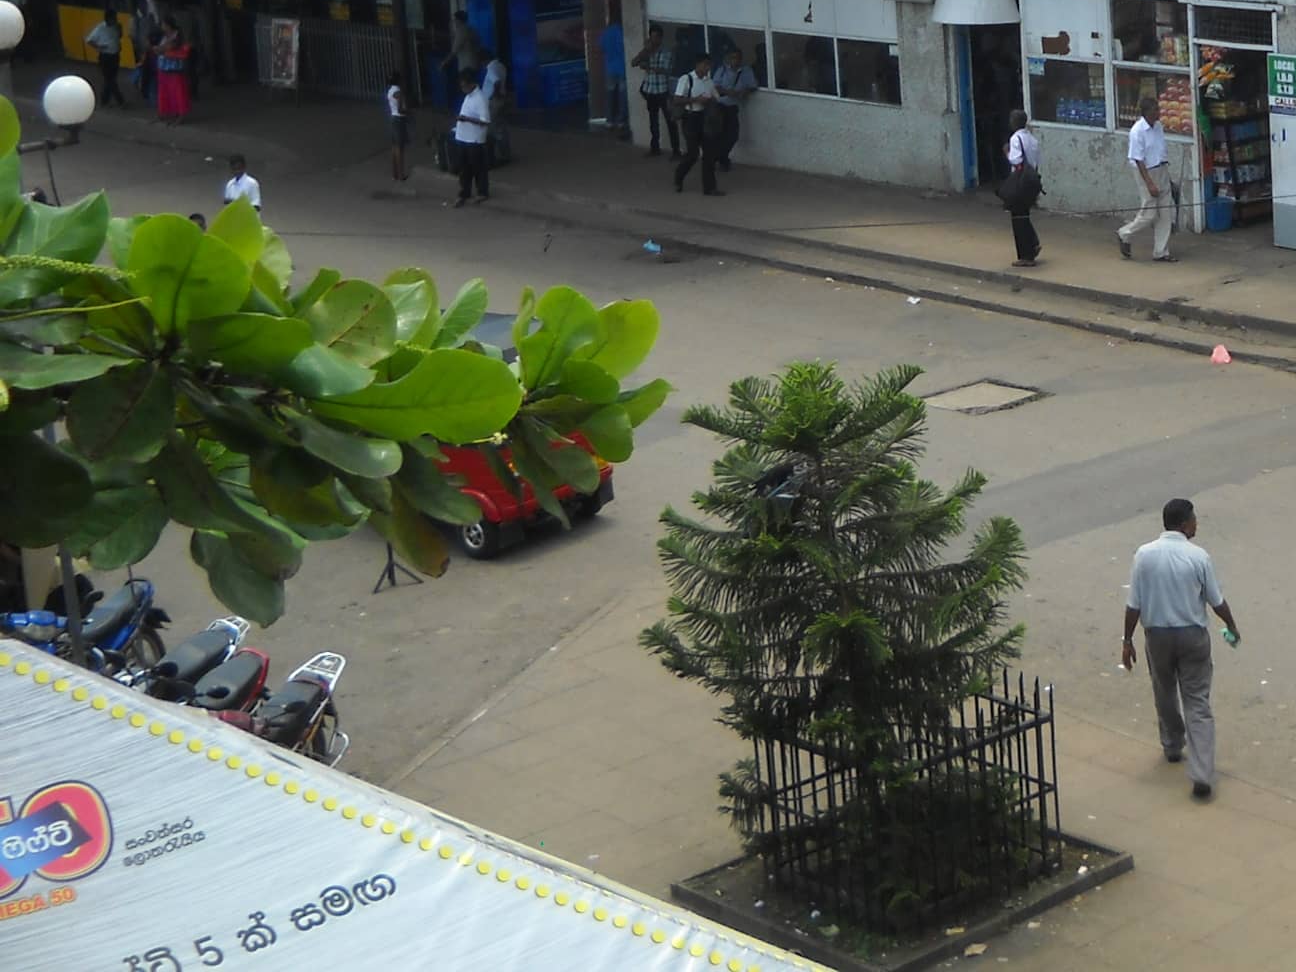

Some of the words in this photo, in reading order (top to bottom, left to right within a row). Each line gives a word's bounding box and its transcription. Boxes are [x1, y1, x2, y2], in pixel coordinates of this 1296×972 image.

[48, 887, 77, 906] 50
[193, 936, 224, 966] 5
[237, 911, 277, 953] ක්
